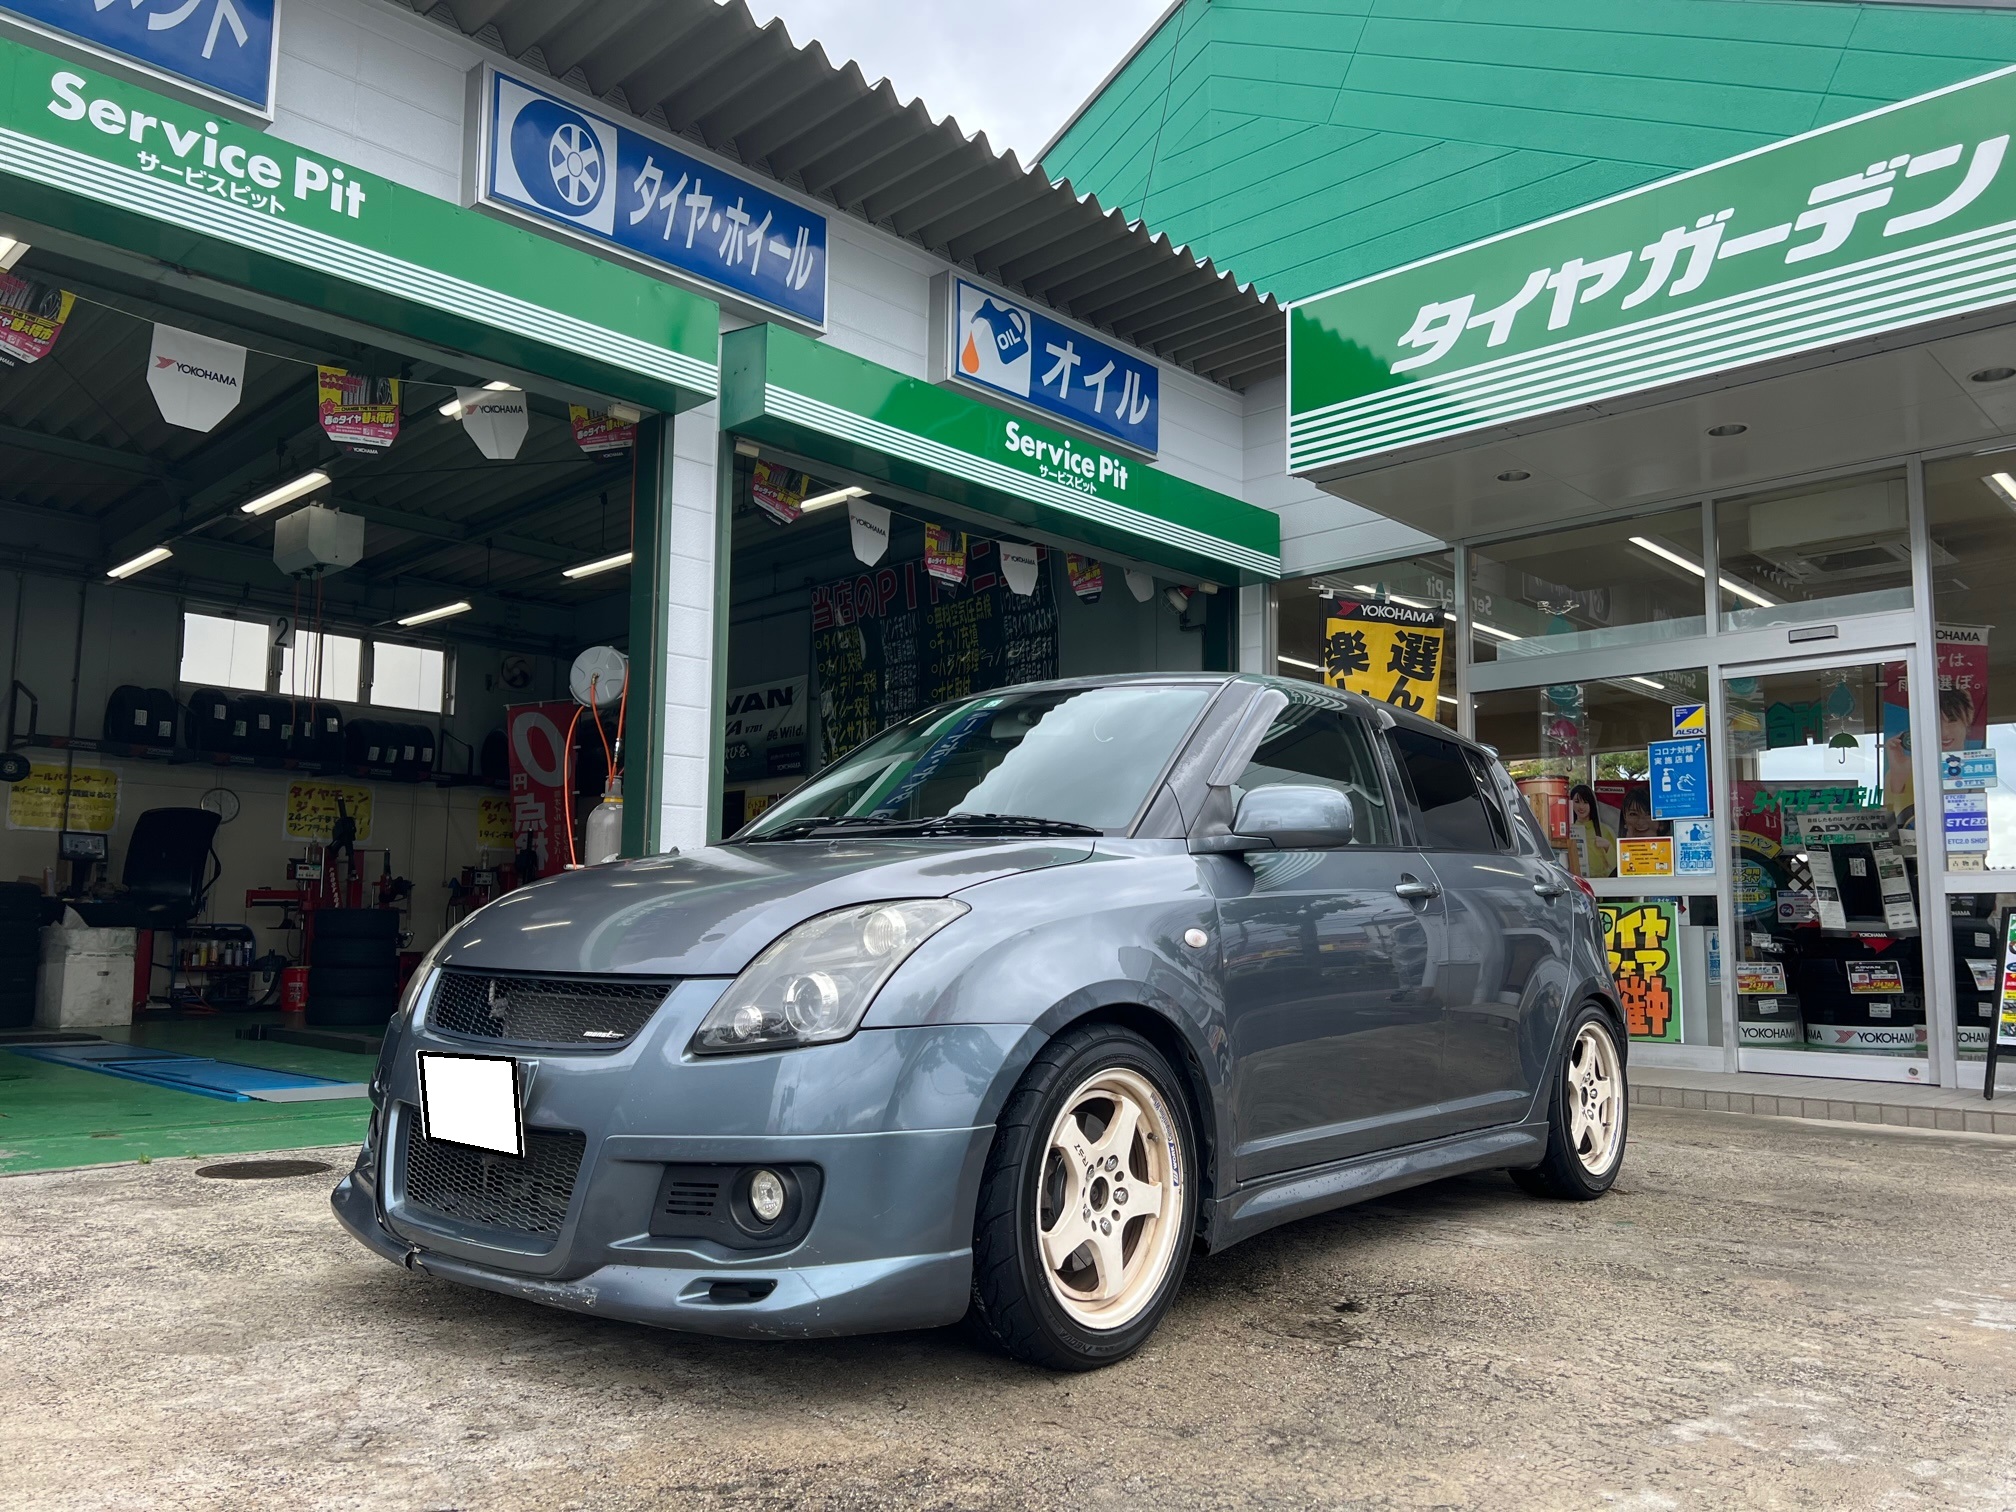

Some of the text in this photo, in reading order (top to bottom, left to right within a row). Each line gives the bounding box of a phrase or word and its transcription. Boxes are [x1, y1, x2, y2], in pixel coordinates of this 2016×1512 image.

[47, 71, 366, 219] Service Pit
[137, 151, 286, 215] サービスピット
[630, 156, 814, 291] タイヤ・ホイール
[1389, 134, 2010, 375] タイヤガーデン
[997, 332, 1021, 352] OIL
[176, 362, 237, 387] YOKOHAMA
[1041, 340, 1150, 426] オイル
[480, 404, 523, 415] YOKOHAMA
[1004, 420, 1129, 491] Service Pit
[1038, 464, 1098, 495] サービスピット
[855, 517, 887, 537] YOKOHAMA
[1011, 555, 1036, 566] YOKOHAMA
[1360, 604, 1435, 624] YOKOHAMA
[274, 617, 289, 647] 2
[1935, 629, 1981, 642] OHAMA
[1675, 727, 1704, 736] ALSOK
[1653, 755, 1694, 766] 実施店舗
[1654, 745, 1694, 756] コロナ対策
[1964, 763, 1994, 774] 会員店
[1809, 822, 1888, 833] ADVAN
[1946, 817, 1987, 827] ETC 2.0
[1680, 850, 1712, 861] 消毒液
[583, 1030, 625, 1039] monster
[1170, 1144, 1178, 1170] WORK
